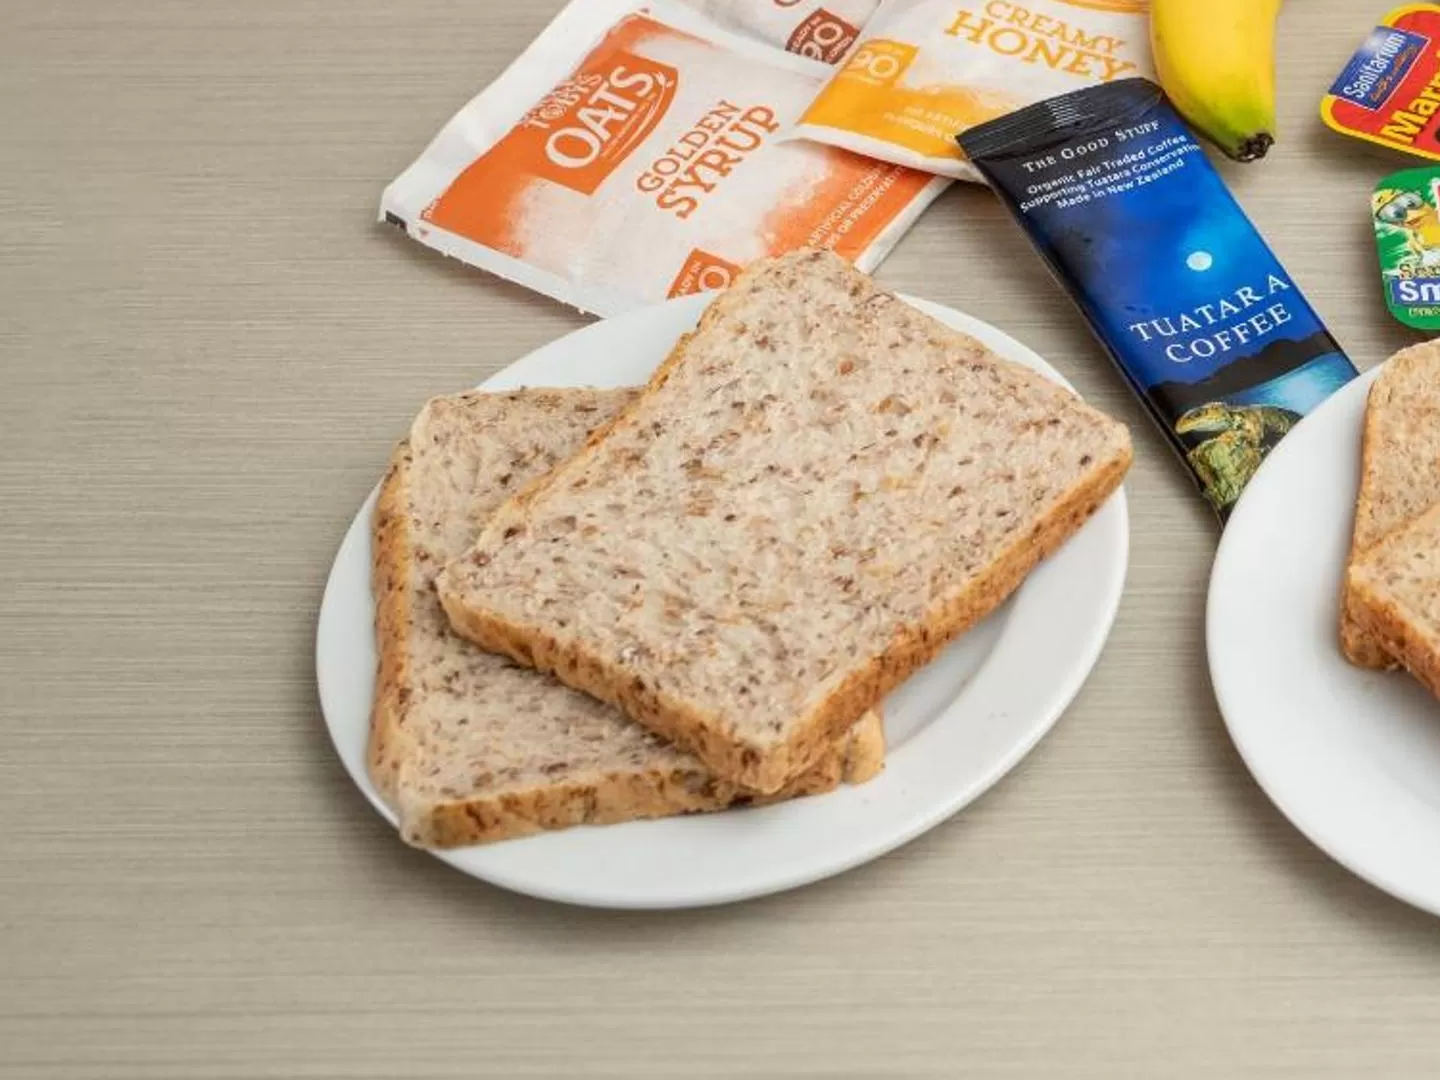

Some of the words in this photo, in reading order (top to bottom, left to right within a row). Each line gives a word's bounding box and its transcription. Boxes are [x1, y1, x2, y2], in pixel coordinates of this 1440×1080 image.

[945, 10, 1137, 83] HONEY
[1342, 32, 1407, 99] Sanitarium
[545, 65, 653, 169] OATS
[637, 99, 741, 192] GOLDEN
[656, 106, 780, 219] SYRUP
[1020, 182, 1086, 213] Supporting
[1087, 168, 1132, 190] Tuatara
[1026, 174, 1075, 197] Organic
[1077, 162, 1102, 181] Fair
[1103, 148, 1146, 170] Traded
[1147, 134, 1188, 156] Coffee
[1056, 193, 1092, 209] Made
[1094, 189, 1106, 199] in
[1107, 180, 1136, 195] New
[1136, 157, 1185, 187] Zealand
[1130, 274, 1290, 342] TUATARA
[1165, 303, 1292, 363] COFFEE
